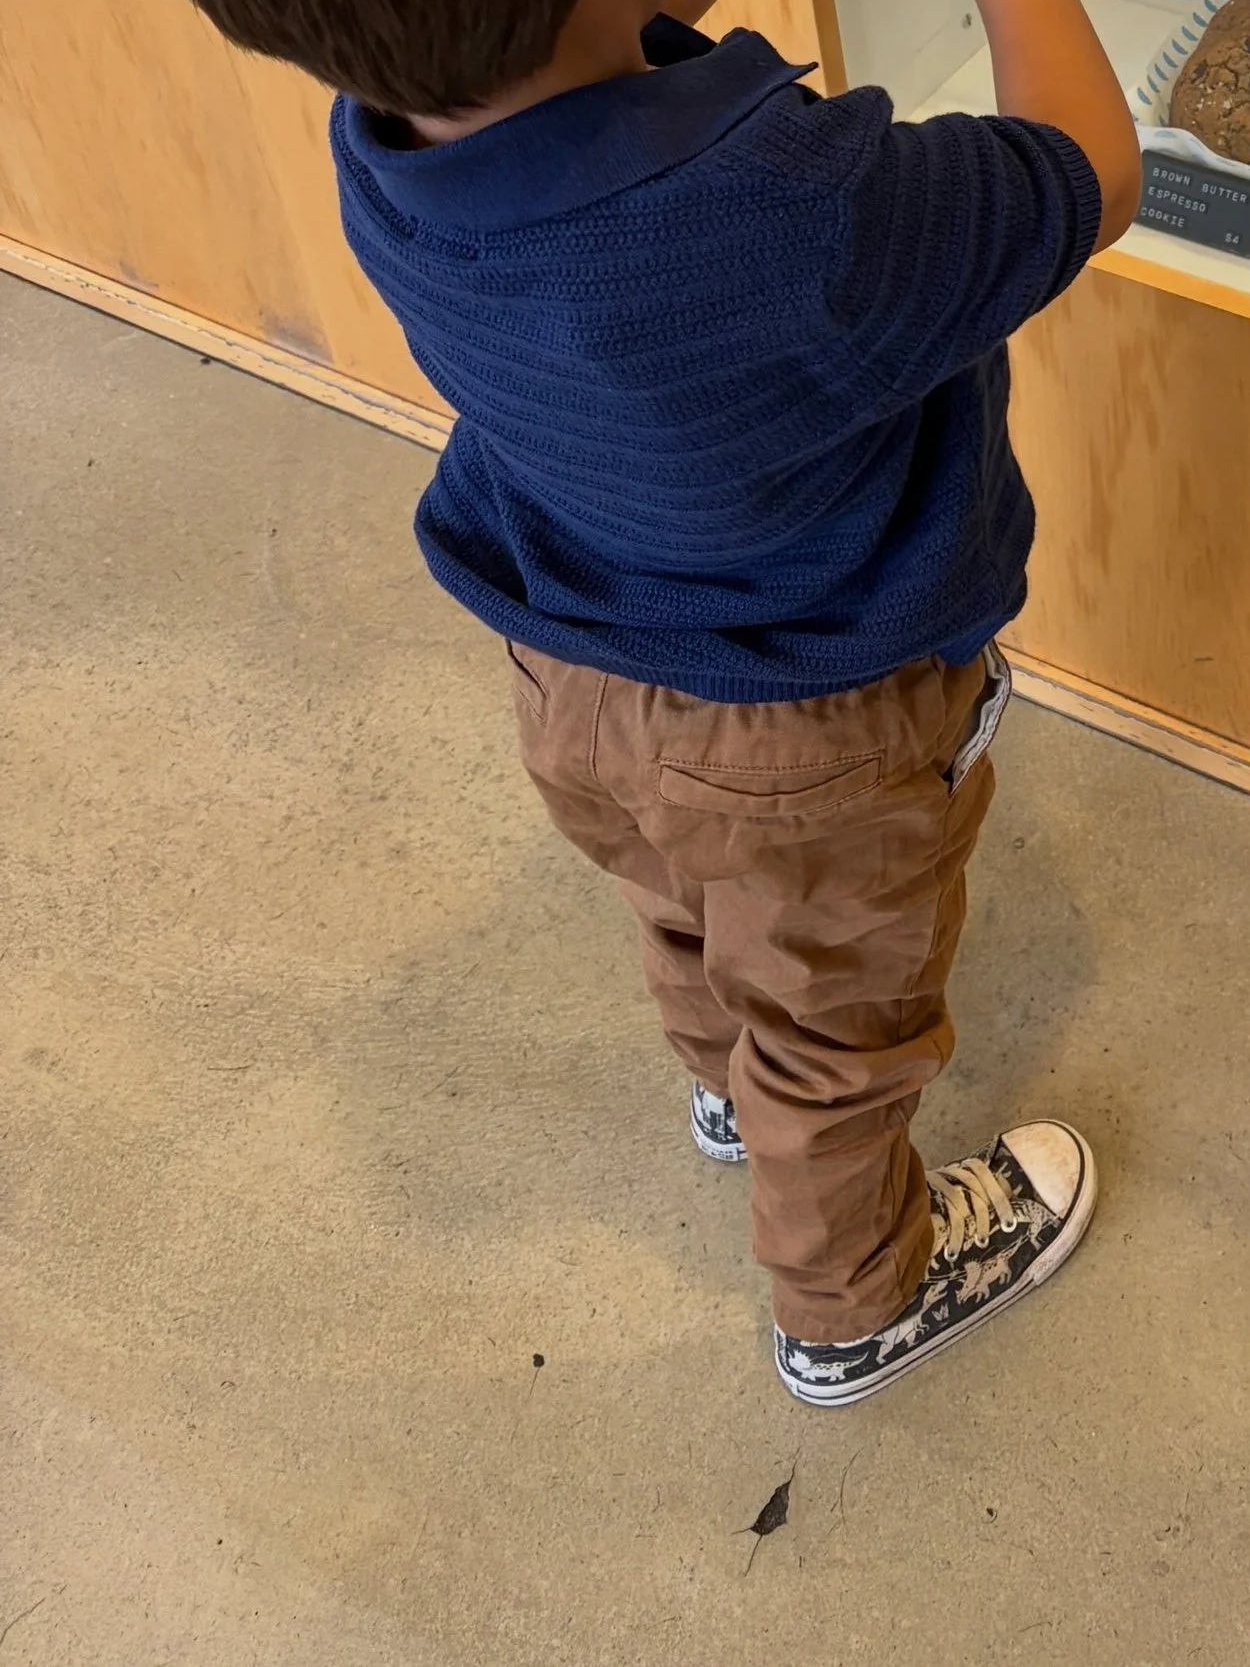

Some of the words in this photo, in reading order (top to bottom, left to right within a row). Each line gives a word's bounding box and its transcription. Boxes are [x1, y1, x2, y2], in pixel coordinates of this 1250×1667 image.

[1152, 167, 1191, 186] BROWN
[1202, 183, 1248, 204] BUTTER
[1148, 186, 1207, 213] ESPRESSO
[1141, 207, 1186, 228] COOKIE
